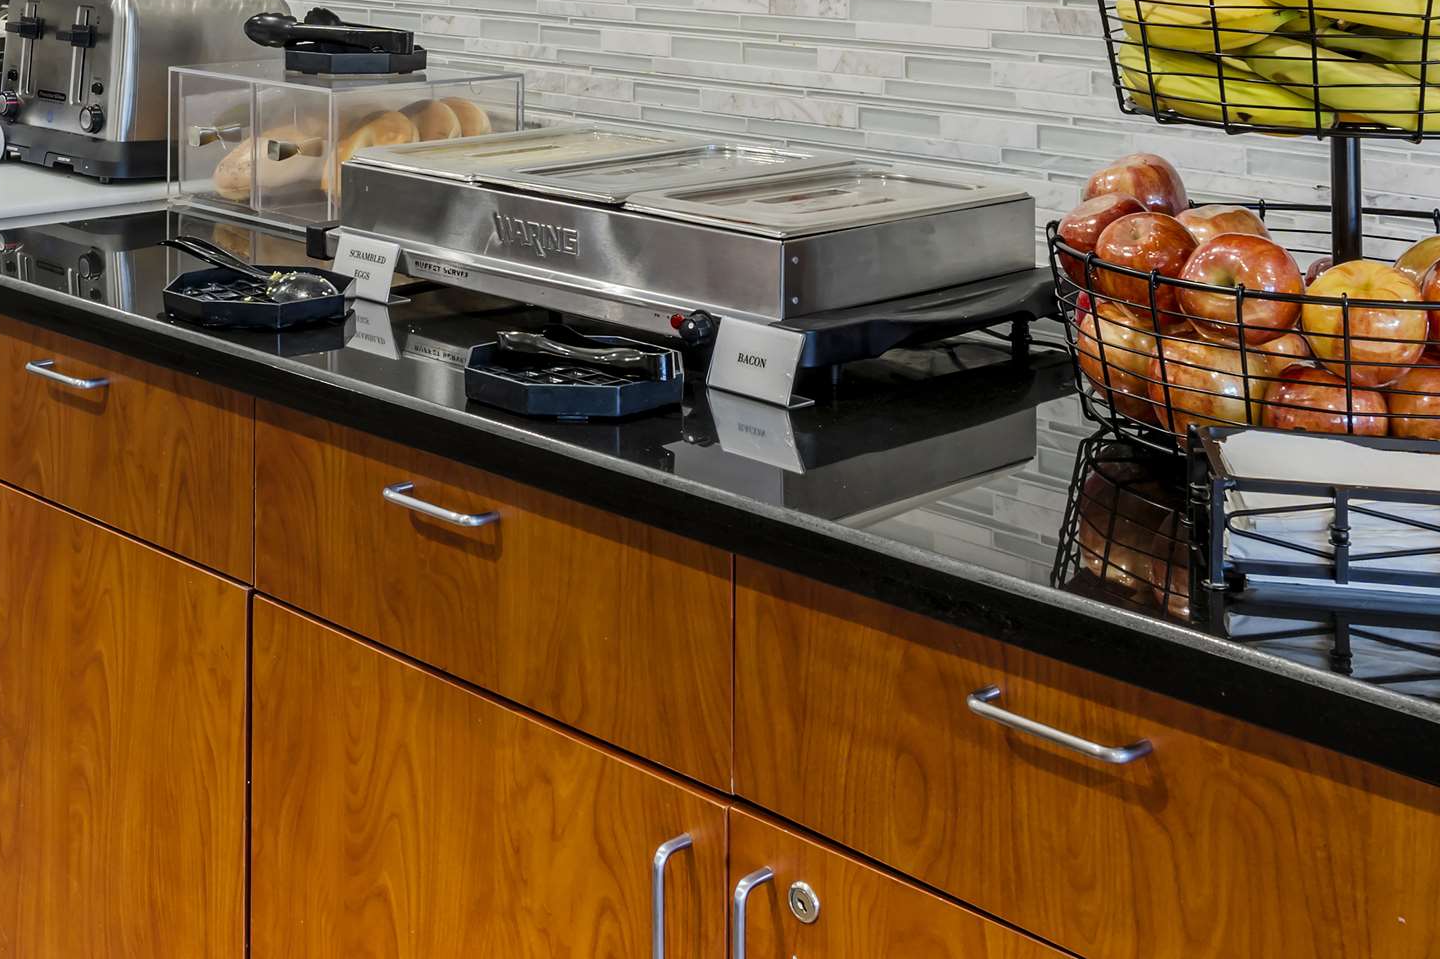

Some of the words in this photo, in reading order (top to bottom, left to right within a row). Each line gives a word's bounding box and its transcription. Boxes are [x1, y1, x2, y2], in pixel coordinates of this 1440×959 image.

[493, 212, 579, 258] WARING
[348, 249, 387, 265] SCRAMBLED
[353, 269, 370, 280] EGGS
[415, 260, 441, 273] BUFFET
[737, 352, 767, 369] BACON
